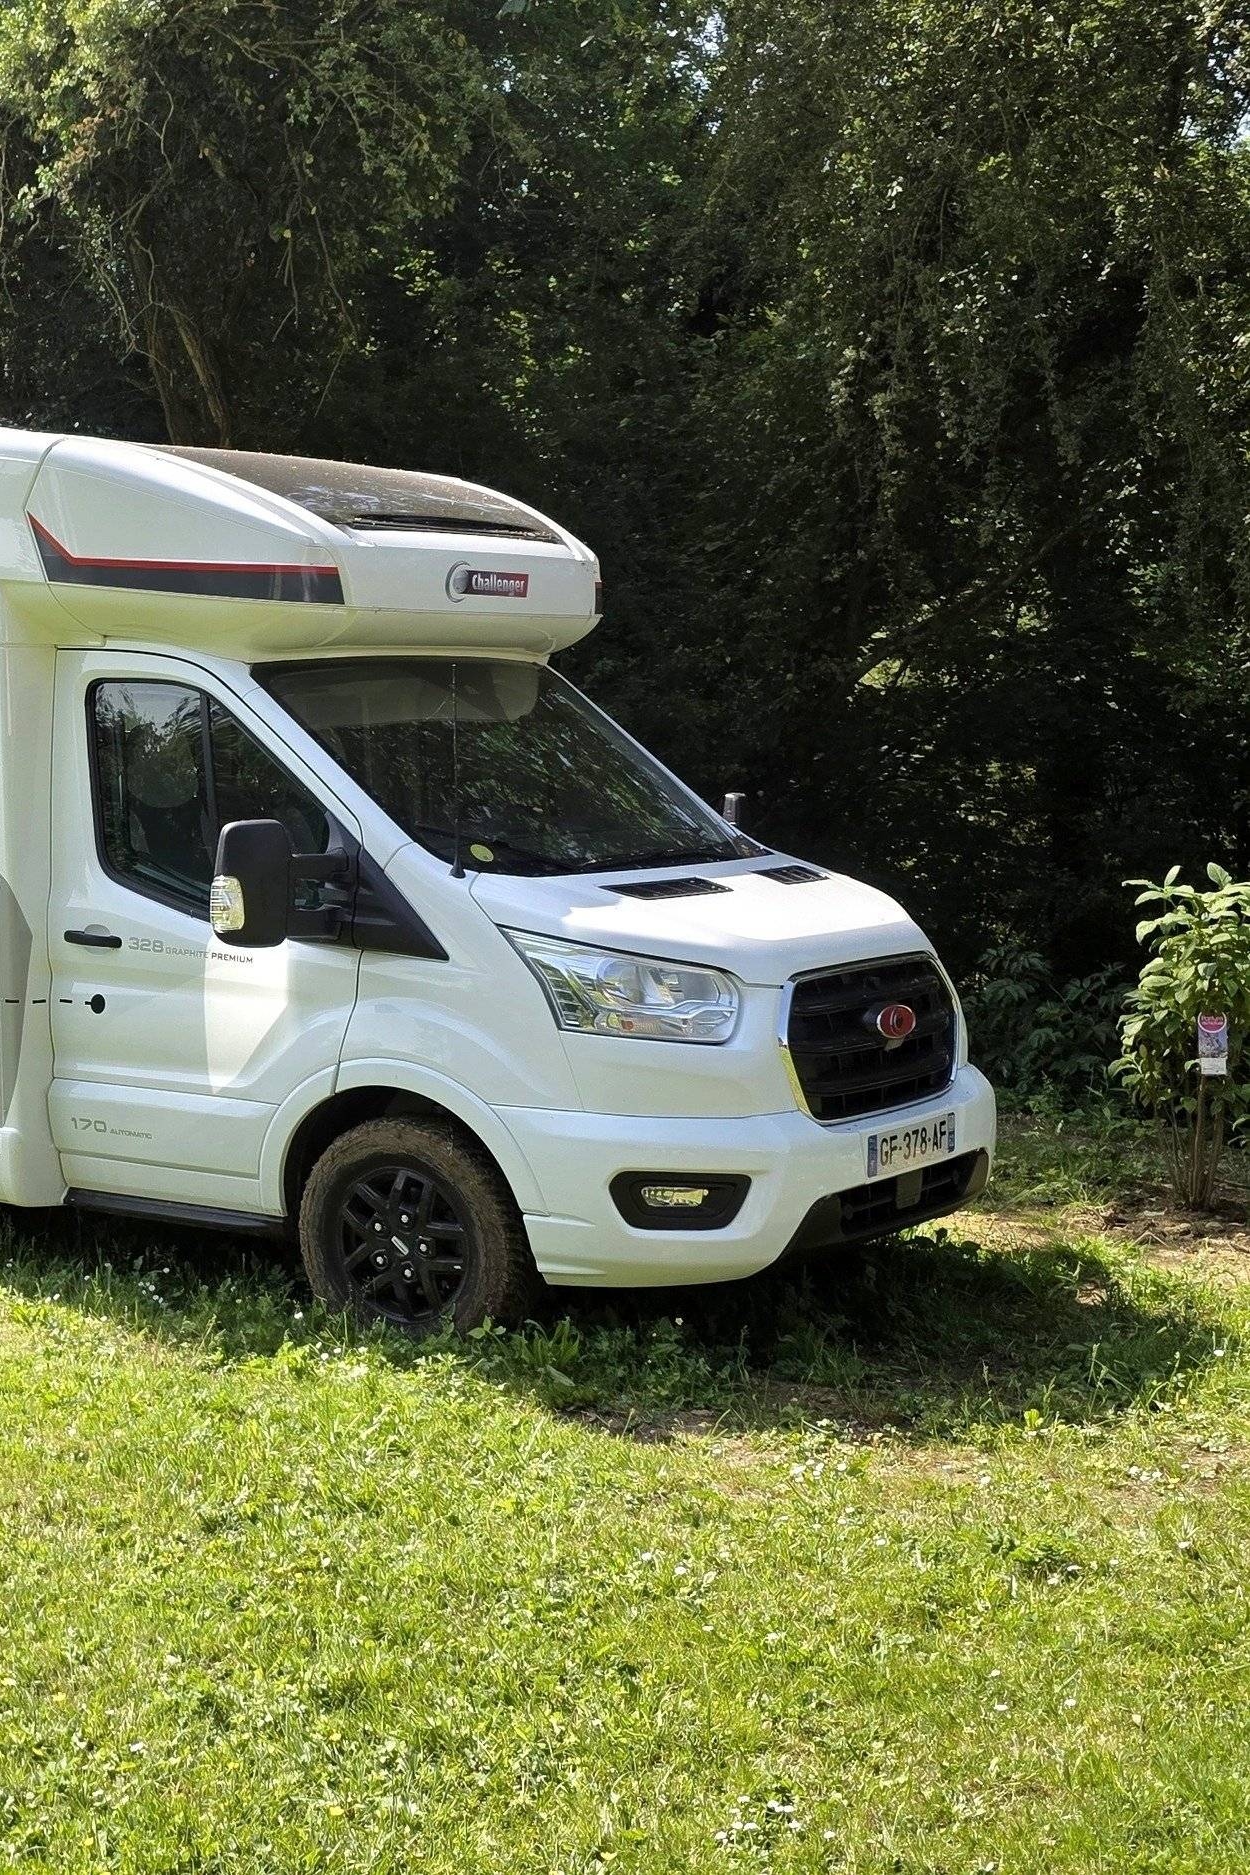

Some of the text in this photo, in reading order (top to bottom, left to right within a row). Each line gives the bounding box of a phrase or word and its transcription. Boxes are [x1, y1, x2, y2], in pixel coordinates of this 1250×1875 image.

[471, 573, 525, 596] Challenger
[128, 937, 253, 963] 328 GRAPHITE PREMIUM
[71, 1117, 153, 1140] 170 AUTOMATIC
[879, 1120, 947, 1167] GF-378-AF
